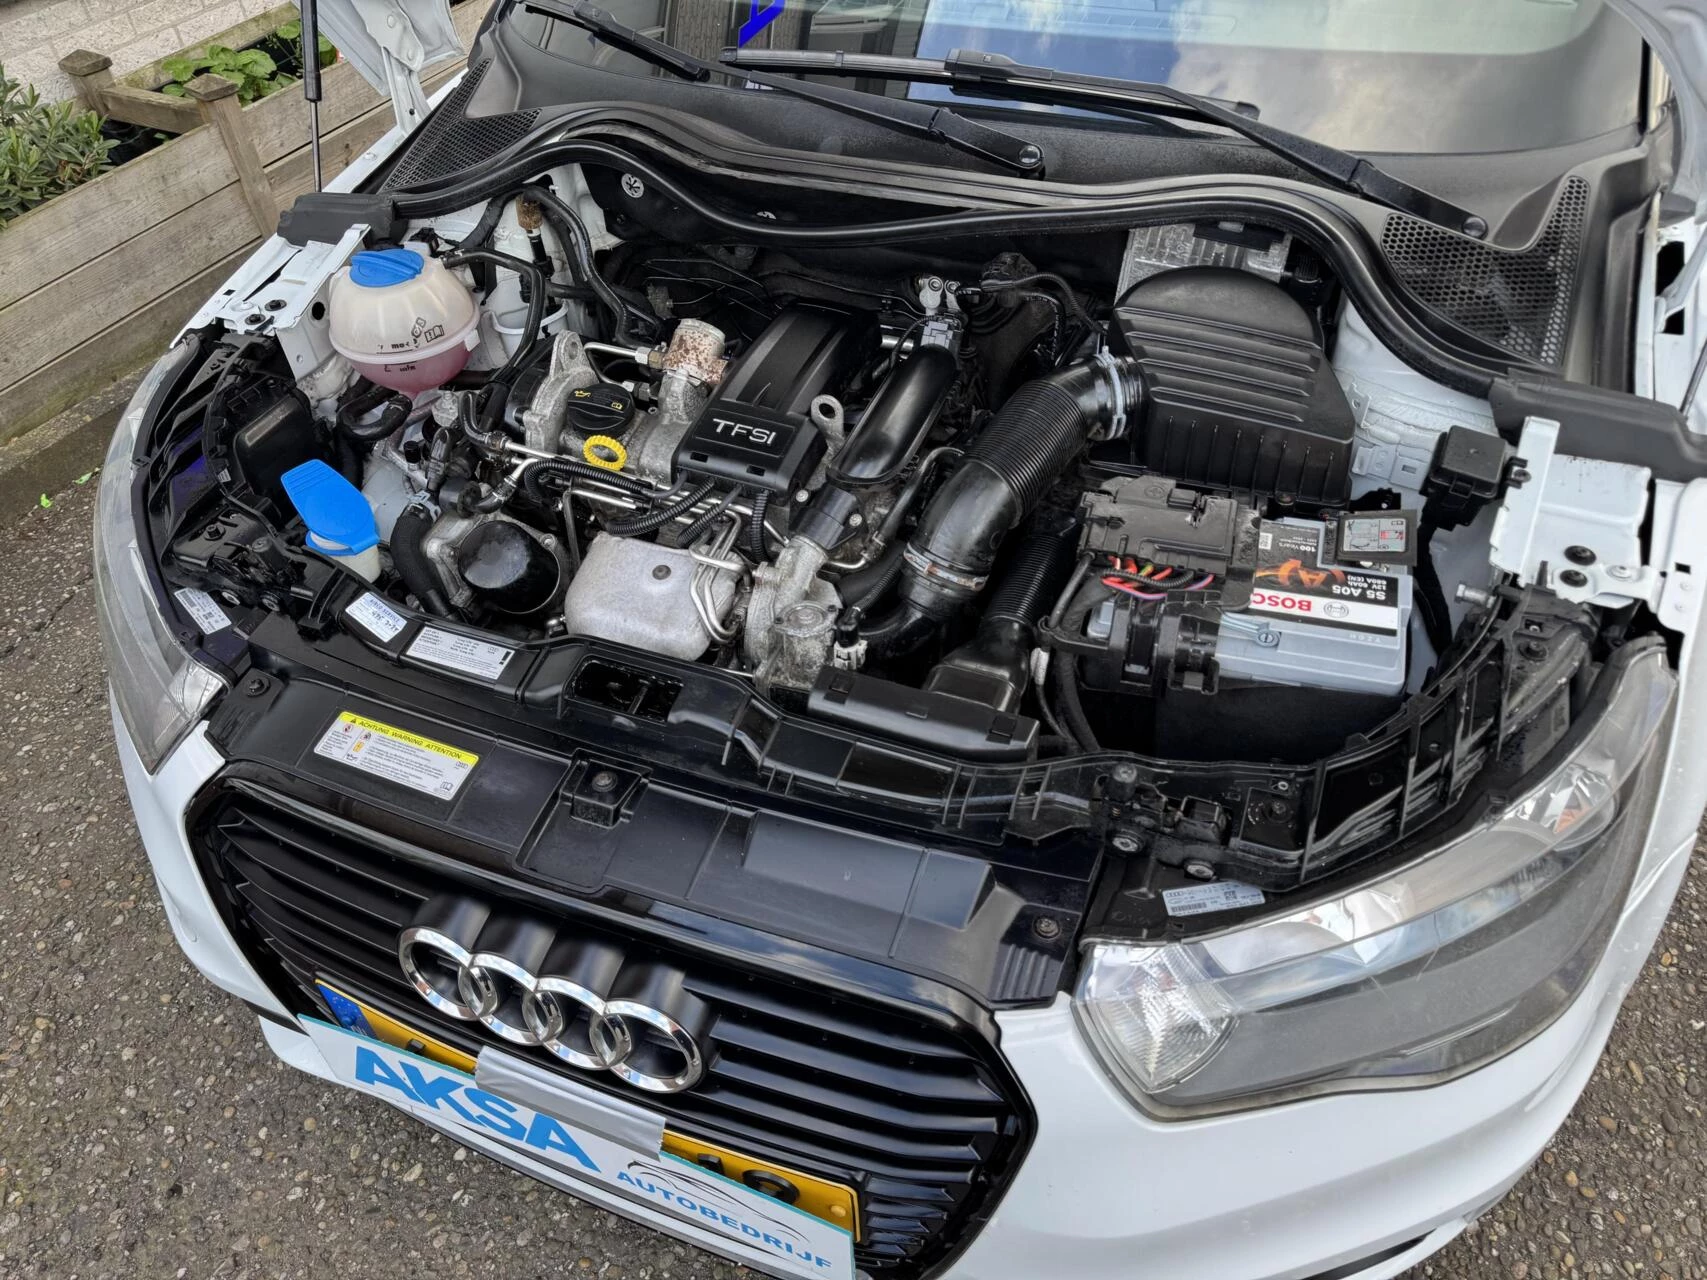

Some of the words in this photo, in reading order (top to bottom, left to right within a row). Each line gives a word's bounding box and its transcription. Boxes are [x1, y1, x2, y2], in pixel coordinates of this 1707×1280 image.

[712, 418, 777, 445] TFSI
[1250, 593, 1312, 612] BOSC
[1331, 585, 1362, 598] A05
[1366, 590, 1387, 600] S5
[358, 721, 389, 735] ACHTUNG
[391, 731, 424, 746] WARNING
[425, 743, 462, 760] ATTENTION
[355, 1046, 602, 1173] AKSA
[617, 1170, 833, 1269] AUTOBEDRIJF
